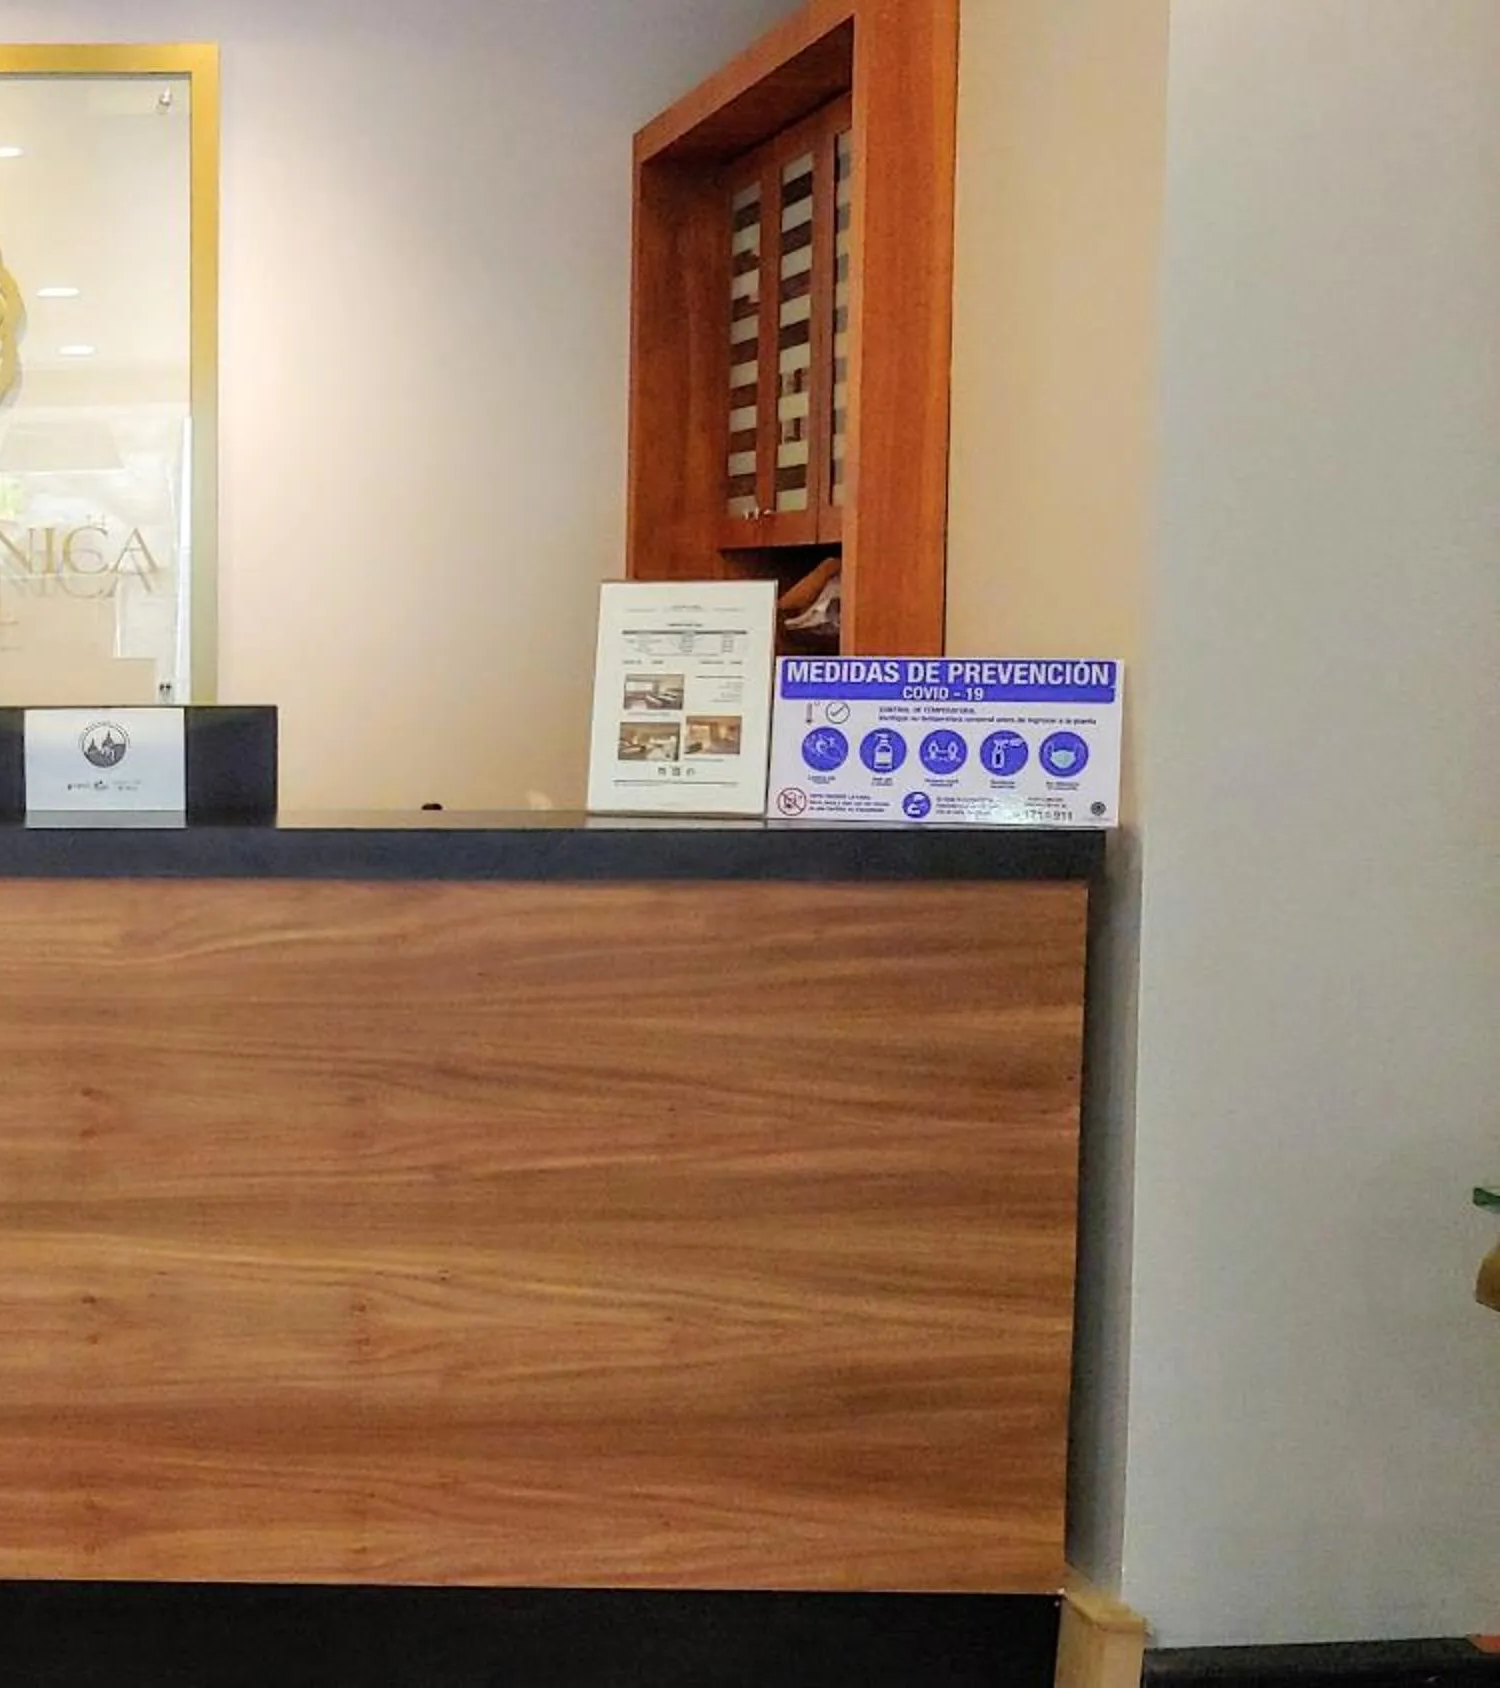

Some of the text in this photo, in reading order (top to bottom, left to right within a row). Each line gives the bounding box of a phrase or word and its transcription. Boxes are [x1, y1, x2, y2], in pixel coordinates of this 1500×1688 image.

[787, 658, 1109, 686] MEDIDAS DE PREVENCIÓN
[902, 686, 949, 700] COVID
[966, 687, 984, 701] 19
